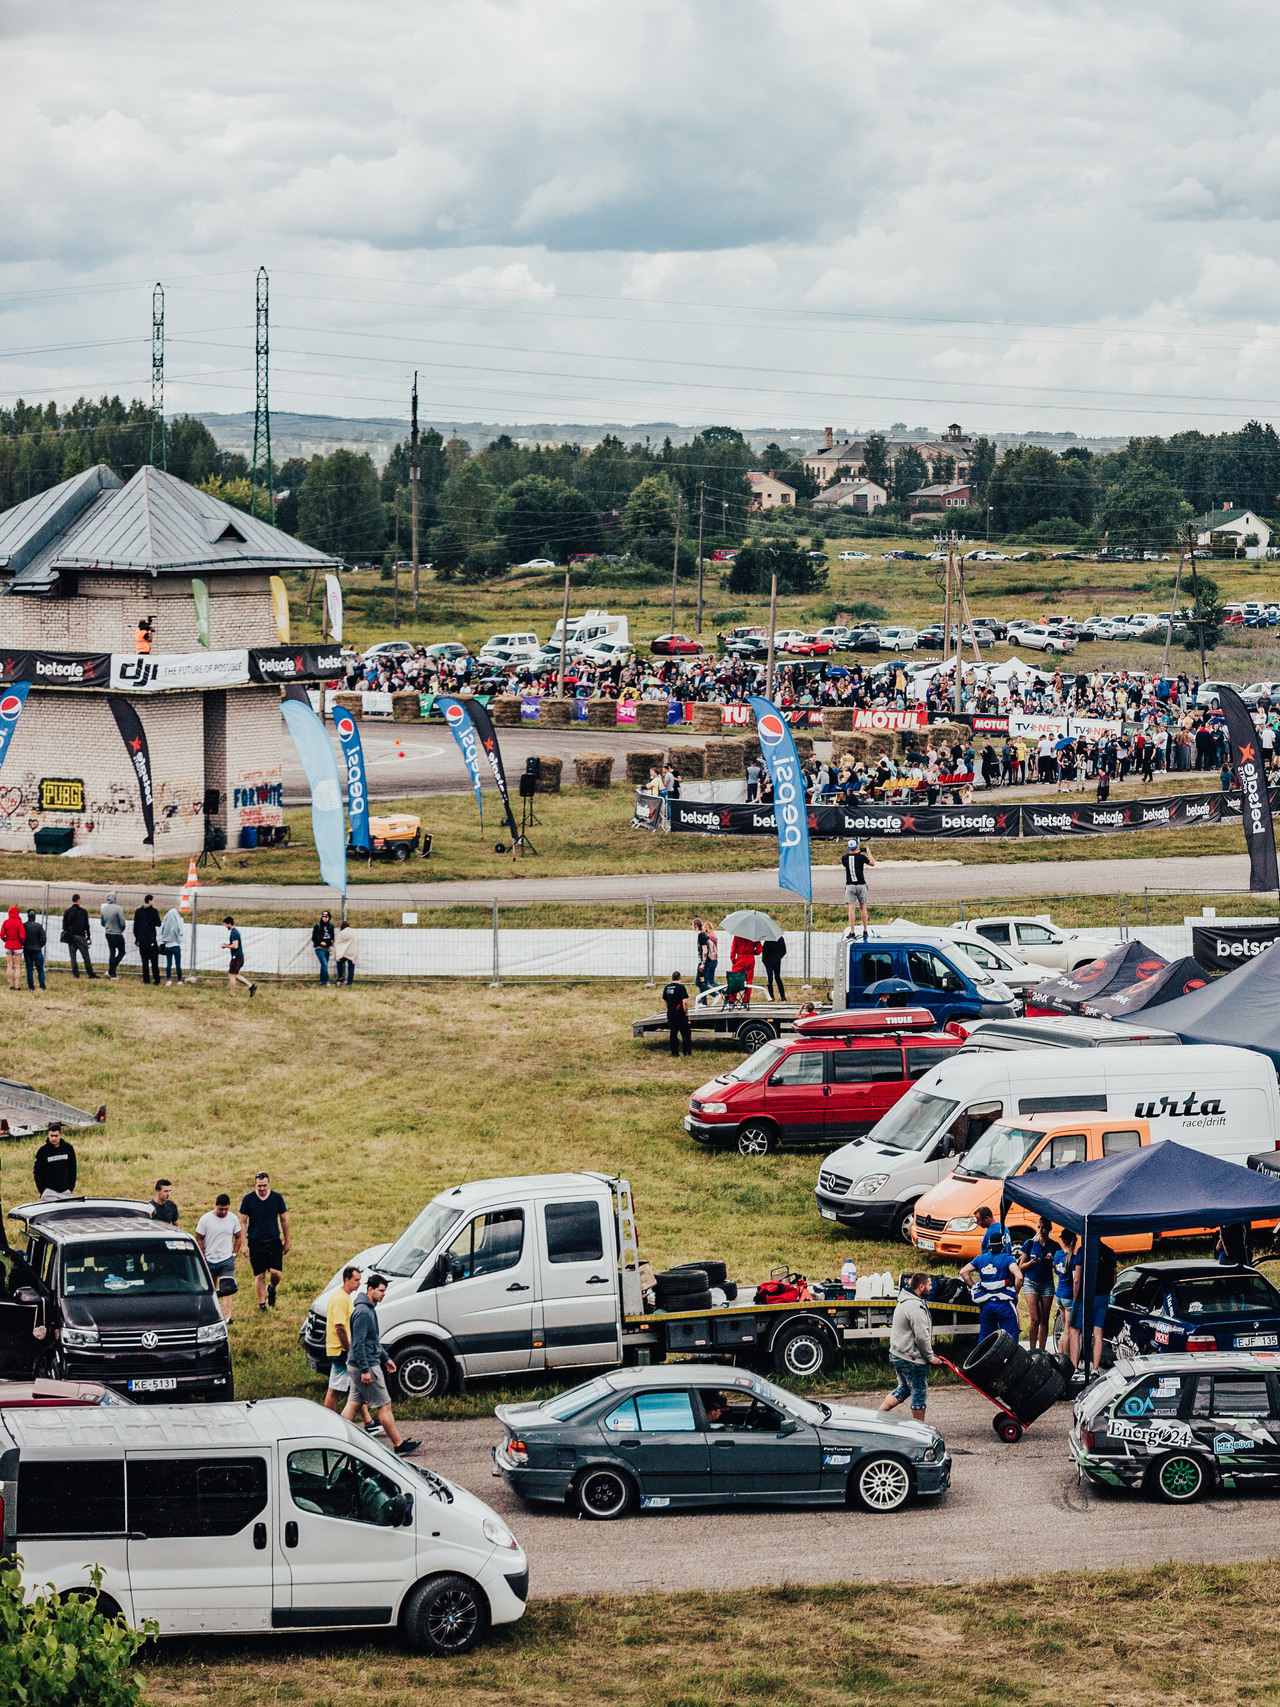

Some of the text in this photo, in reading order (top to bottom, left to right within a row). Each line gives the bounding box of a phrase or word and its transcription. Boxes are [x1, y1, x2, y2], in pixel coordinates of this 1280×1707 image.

[36, 660, 84, 676] betsafe
[164, 662, 243, 676] THE FUTURE OF POSSIBLE
[258, 657, 296, 673] betsafe
[855, 711, 921, 729] MOTUL
[974, 719, 1008, 731] MOTUL
[45, 785, 78, 805] PUBG
[1143, 808, 1170, 821] betsafe
[1186, 803, 1210, 816] betsafe
[680, 809, 720, 826] betsafe
[844, 815, 901, 829] betsafe
[941, 814, 995, 829] betsafe
[1033, 814, 1072, 827] betsafe
[1093, 811, 1123, 824] betsafe
[885, 1016, 912, 1024] THULE
[1134, 1091, 1226, 1119] urta
[1182, 1117, 1226, 1128] race/drift
[1238, 1336, 1277, 1346] EJF 135
[134, 1378, 175, 1390] KE-5131
